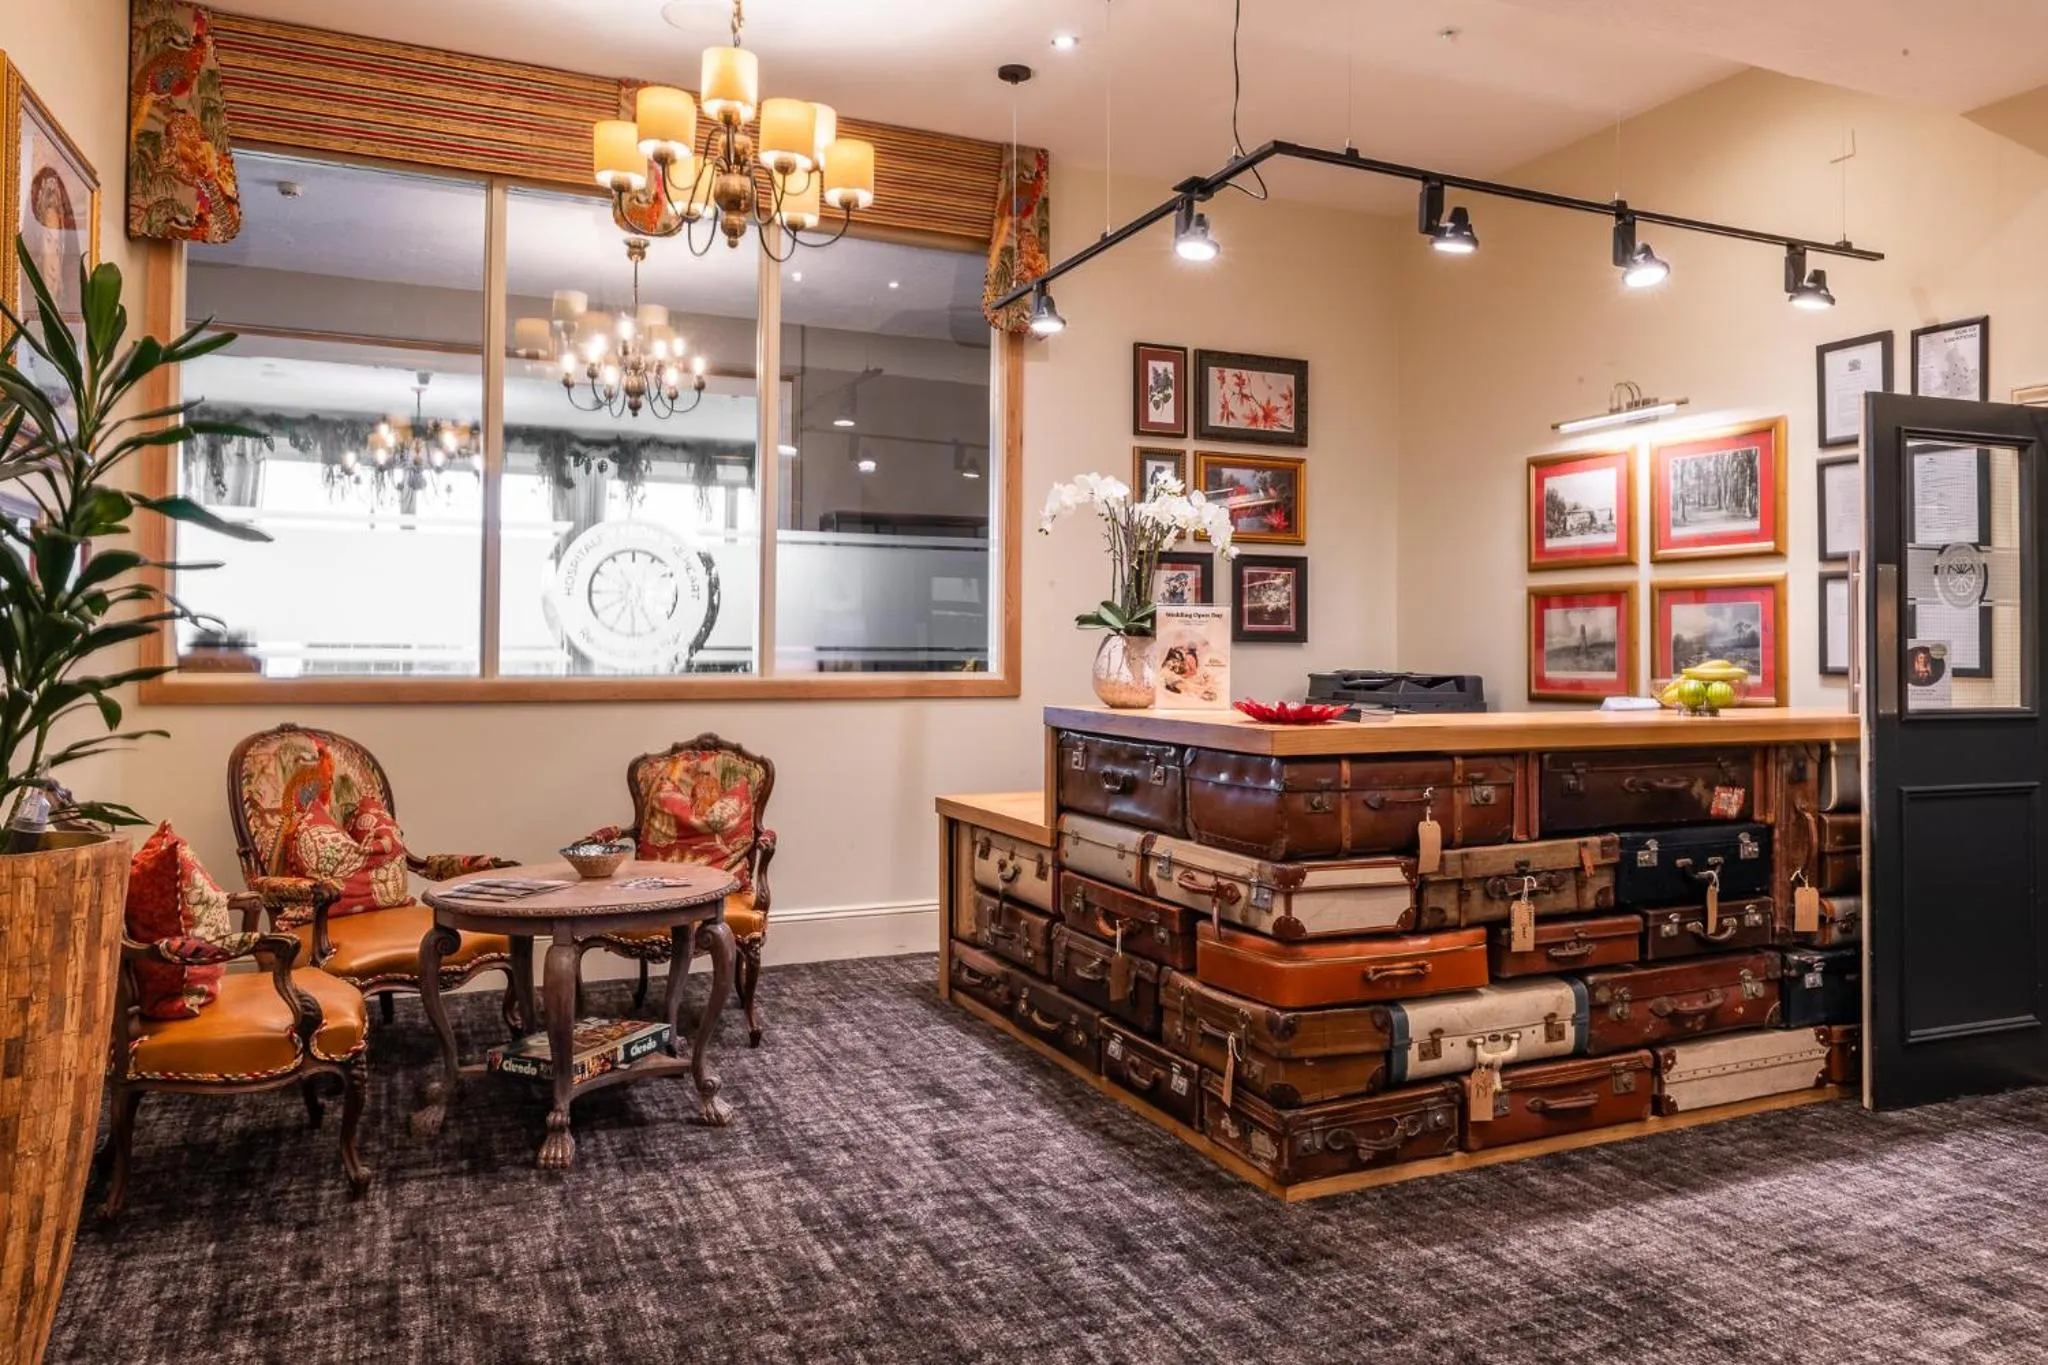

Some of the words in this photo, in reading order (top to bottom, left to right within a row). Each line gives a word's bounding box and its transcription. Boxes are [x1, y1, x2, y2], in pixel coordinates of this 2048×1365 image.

[1166, 611, 1193, 619] Wedding
[1193, 611, 1210, 619] Open
[1210, 611, 1223, 619] Day
[502, 1059, 538, 1076] Cluedo
